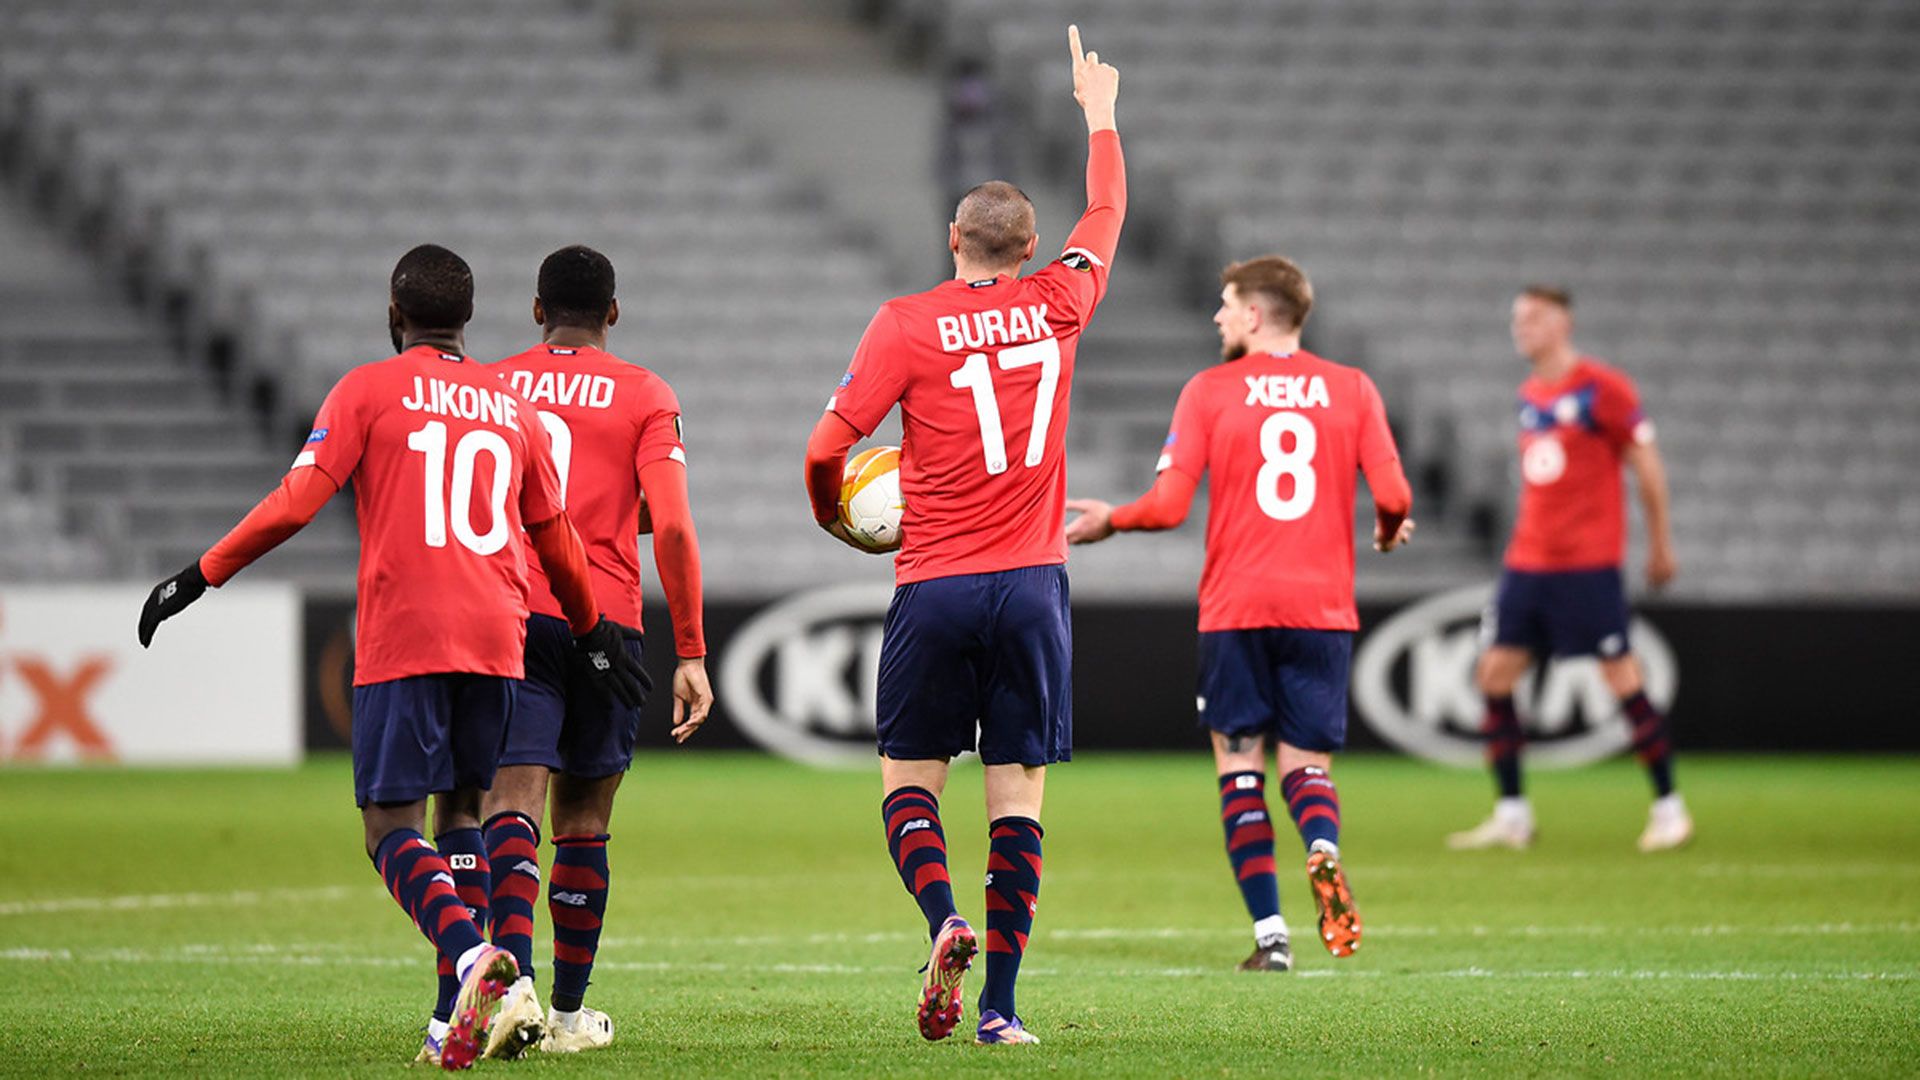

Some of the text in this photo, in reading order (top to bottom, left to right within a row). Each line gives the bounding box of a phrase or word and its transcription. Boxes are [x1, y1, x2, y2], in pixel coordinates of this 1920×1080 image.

[936, 303, 1054, 352] BURAK
[402, 375, 520, 432] J.IKONE
[950, 336, 1061, 475] 17
[1244, 374, 1331, 409] XEKA
[407, 420, 512, 556] 10
[1255, 410, 1318, 522] 8
[453, 856, 475, 868] 10
